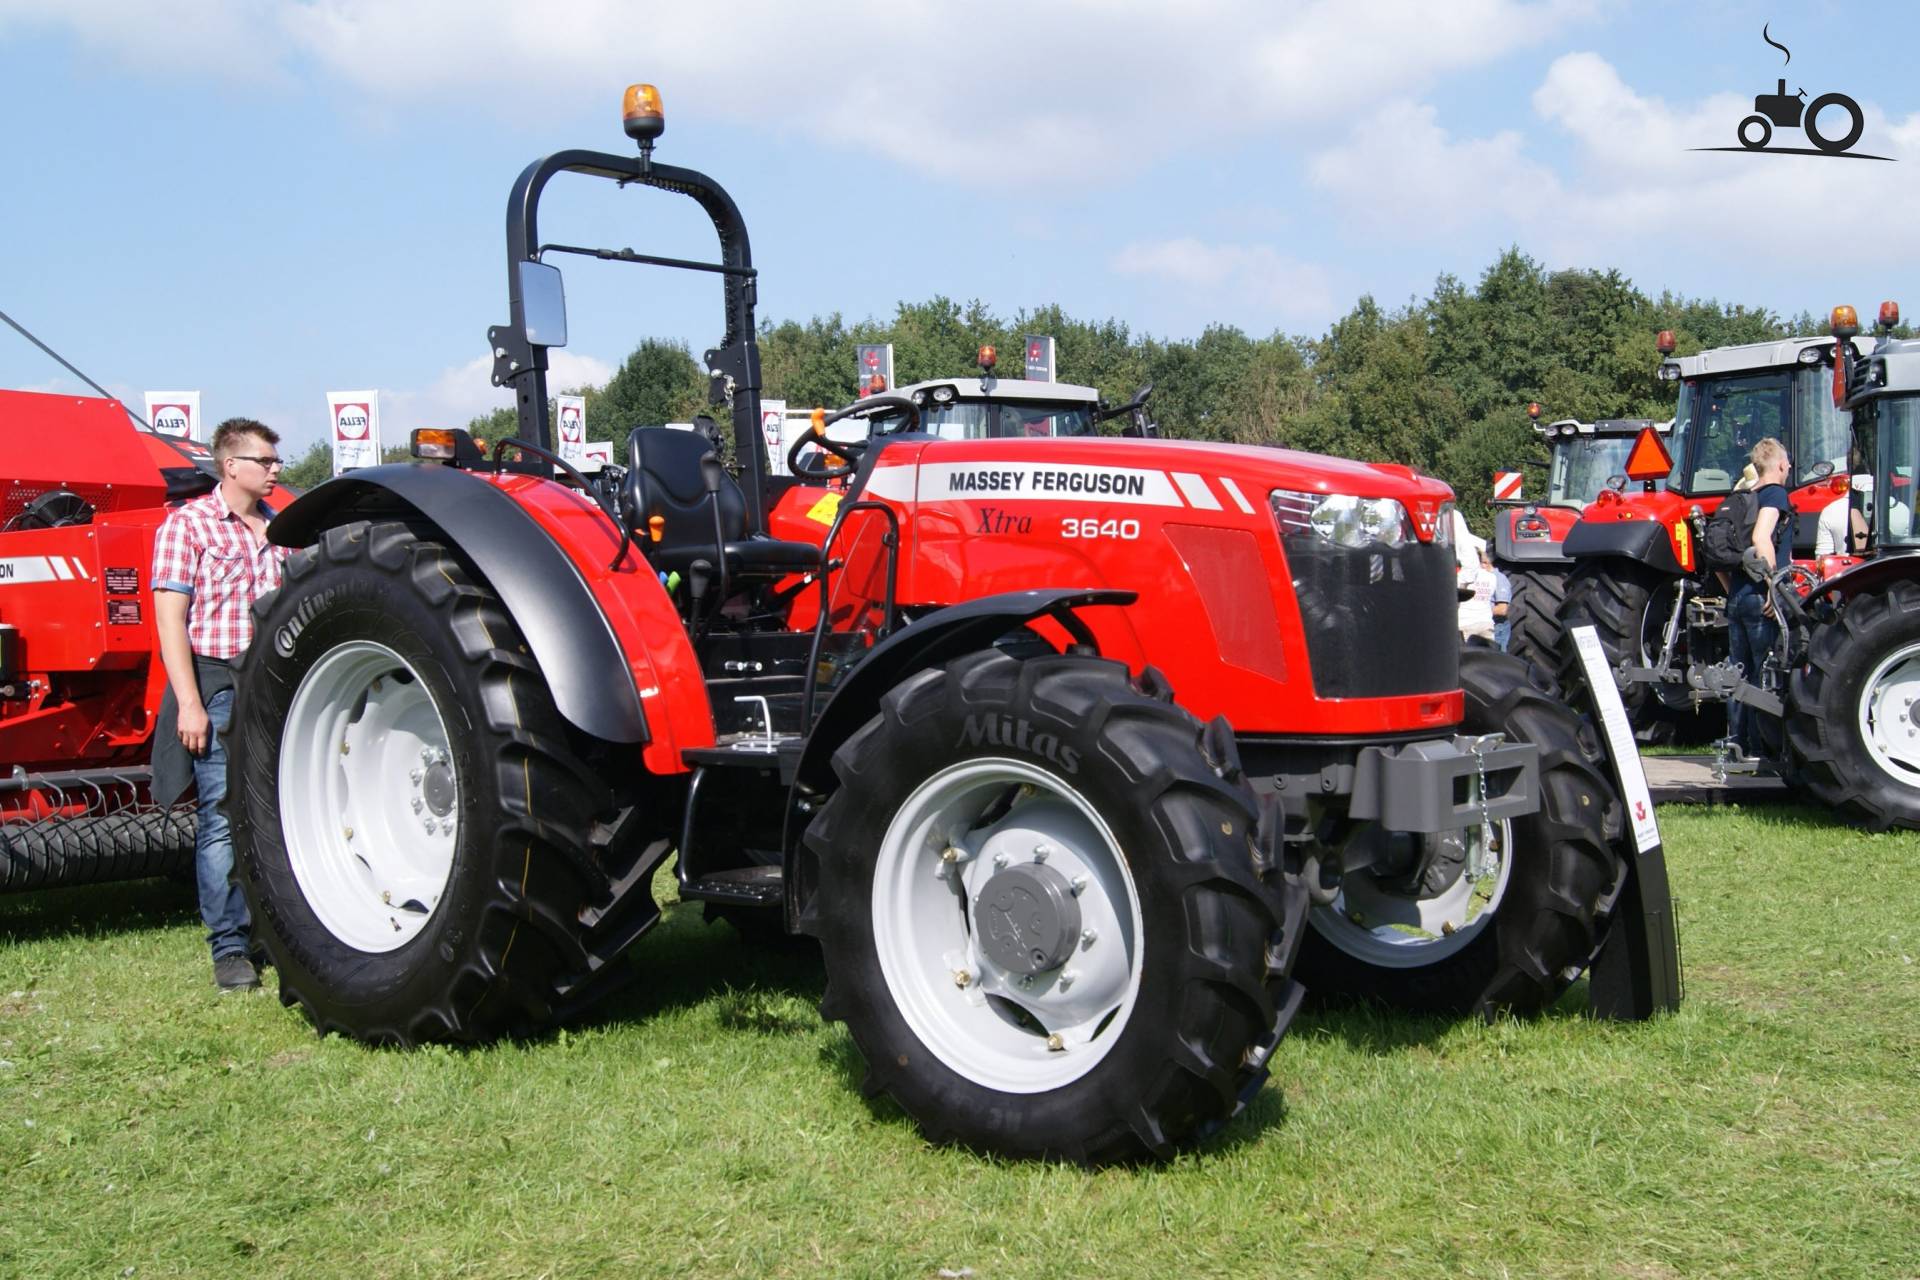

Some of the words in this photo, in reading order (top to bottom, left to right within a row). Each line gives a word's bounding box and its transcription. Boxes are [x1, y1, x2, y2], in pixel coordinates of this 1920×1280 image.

[949, 471, 1025, 492] MASSEY
[1031, 471, 1145, 496] FERGUSON
[976, 507, 1033, 535] Xtra
[1060, 517, 1141, 541] 3640
[954, 711, 1082, 775] Mitas
